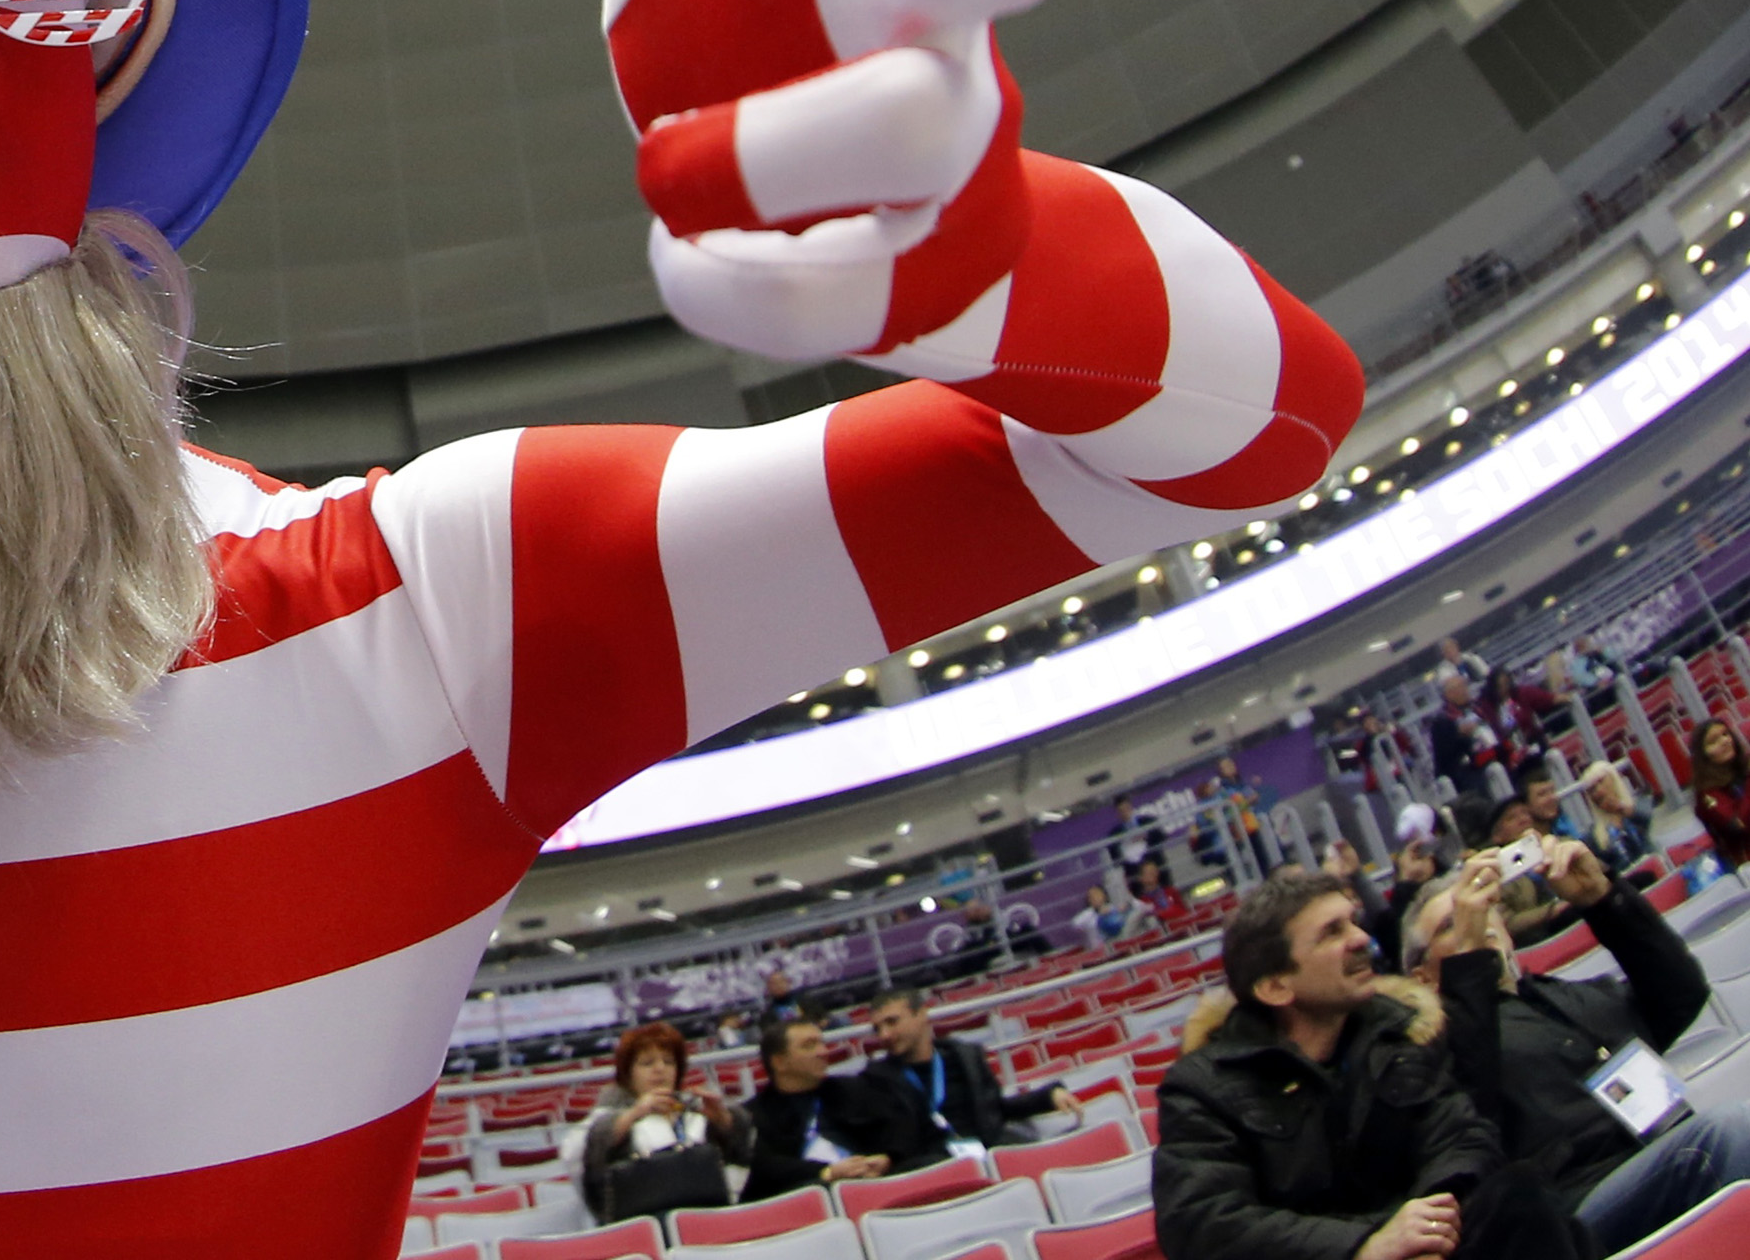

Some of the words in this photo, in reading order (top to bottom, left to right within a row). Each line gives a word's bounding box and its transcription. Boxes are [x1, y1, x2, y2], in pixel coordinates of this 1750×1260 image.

[885, 608, 1214, 768] WELCOME
[1209, 568, 1309, 641] TO
[1305, 499, 1443, 598] THE
[1438, 394, 1619, 534] SOCHI
[1611, 285, 1750, 424] 2014
